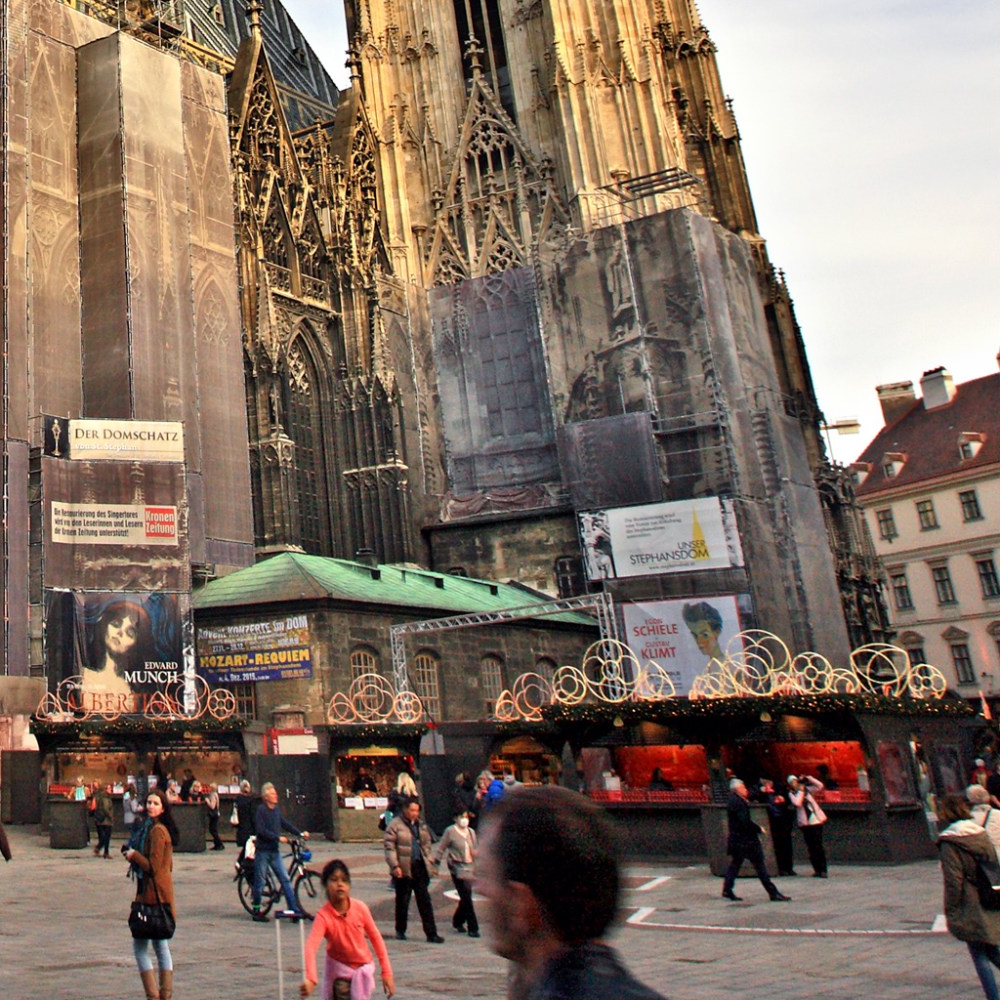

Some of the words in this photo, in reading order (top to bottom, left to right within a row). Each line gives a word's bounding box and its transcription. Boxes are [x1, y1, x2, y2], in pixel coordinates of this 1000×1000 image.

[75, 428, 99, 439] DER
[103, 429, 178, 441] DOMSCHATZ
[97, 510, 106, 518] des
[145, 511, 174, 522] Kronen
[83, 519, 112, 527] Leserinnen
[125, 520, 143, 528] Lesern
[146, 522, 175, 534] Zeitung
[677, 539, 706, 549] UNSER
[629, 548, 709, 565] STEPHANSDOM
[286, 615, 308, 630] DOM
[633, 623, 679, 637] SCHIELE
[641, 646, 676, 659] KLIMT
[144, 661, 178, 670] EDVARD
[124, 670, 178, 684] MUNCH
